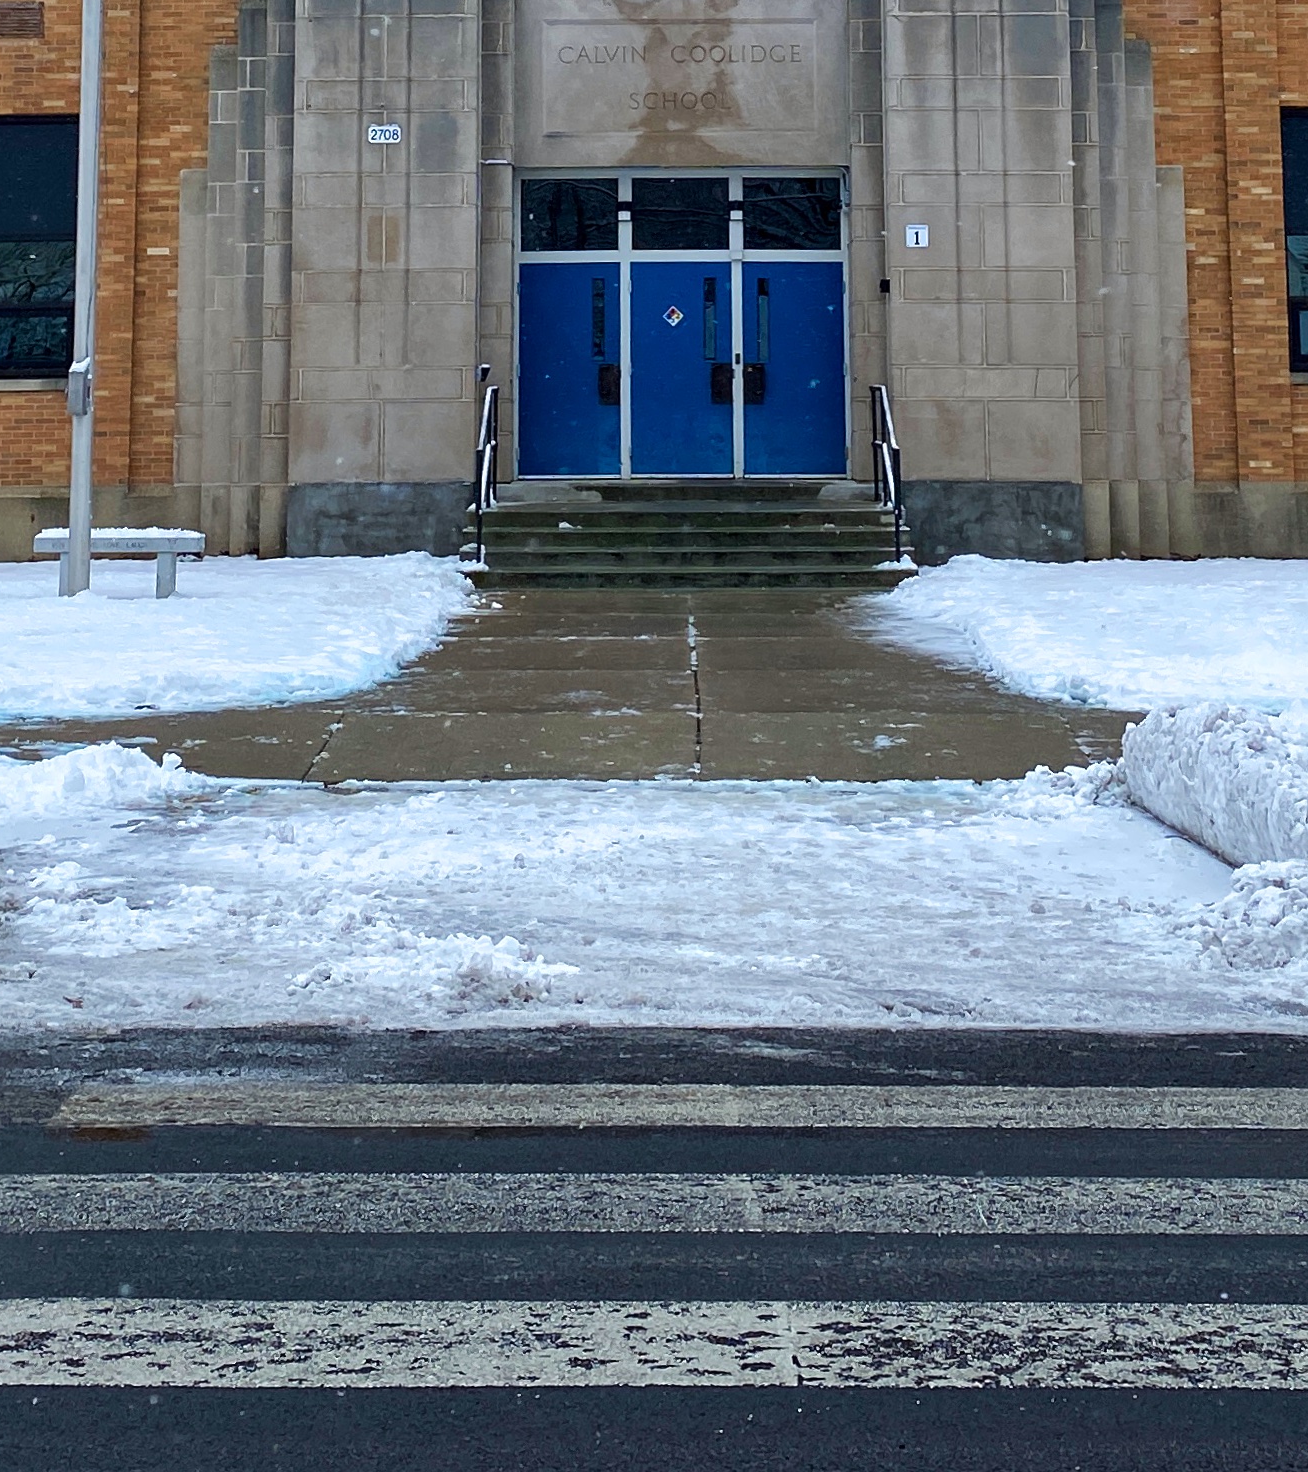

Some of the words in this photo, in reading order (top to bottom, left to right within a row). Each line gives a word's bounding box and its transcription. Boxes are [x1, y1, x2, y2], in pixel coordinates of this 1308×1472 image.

[557, 45, 647, 65] CALVIN
[670, 44, 802, 64] COOLIDGE
[628, 91, 732, 111] SCHOOL
[370, 128, 400, 141] 2708
[914, 230, 921, 246] 1
